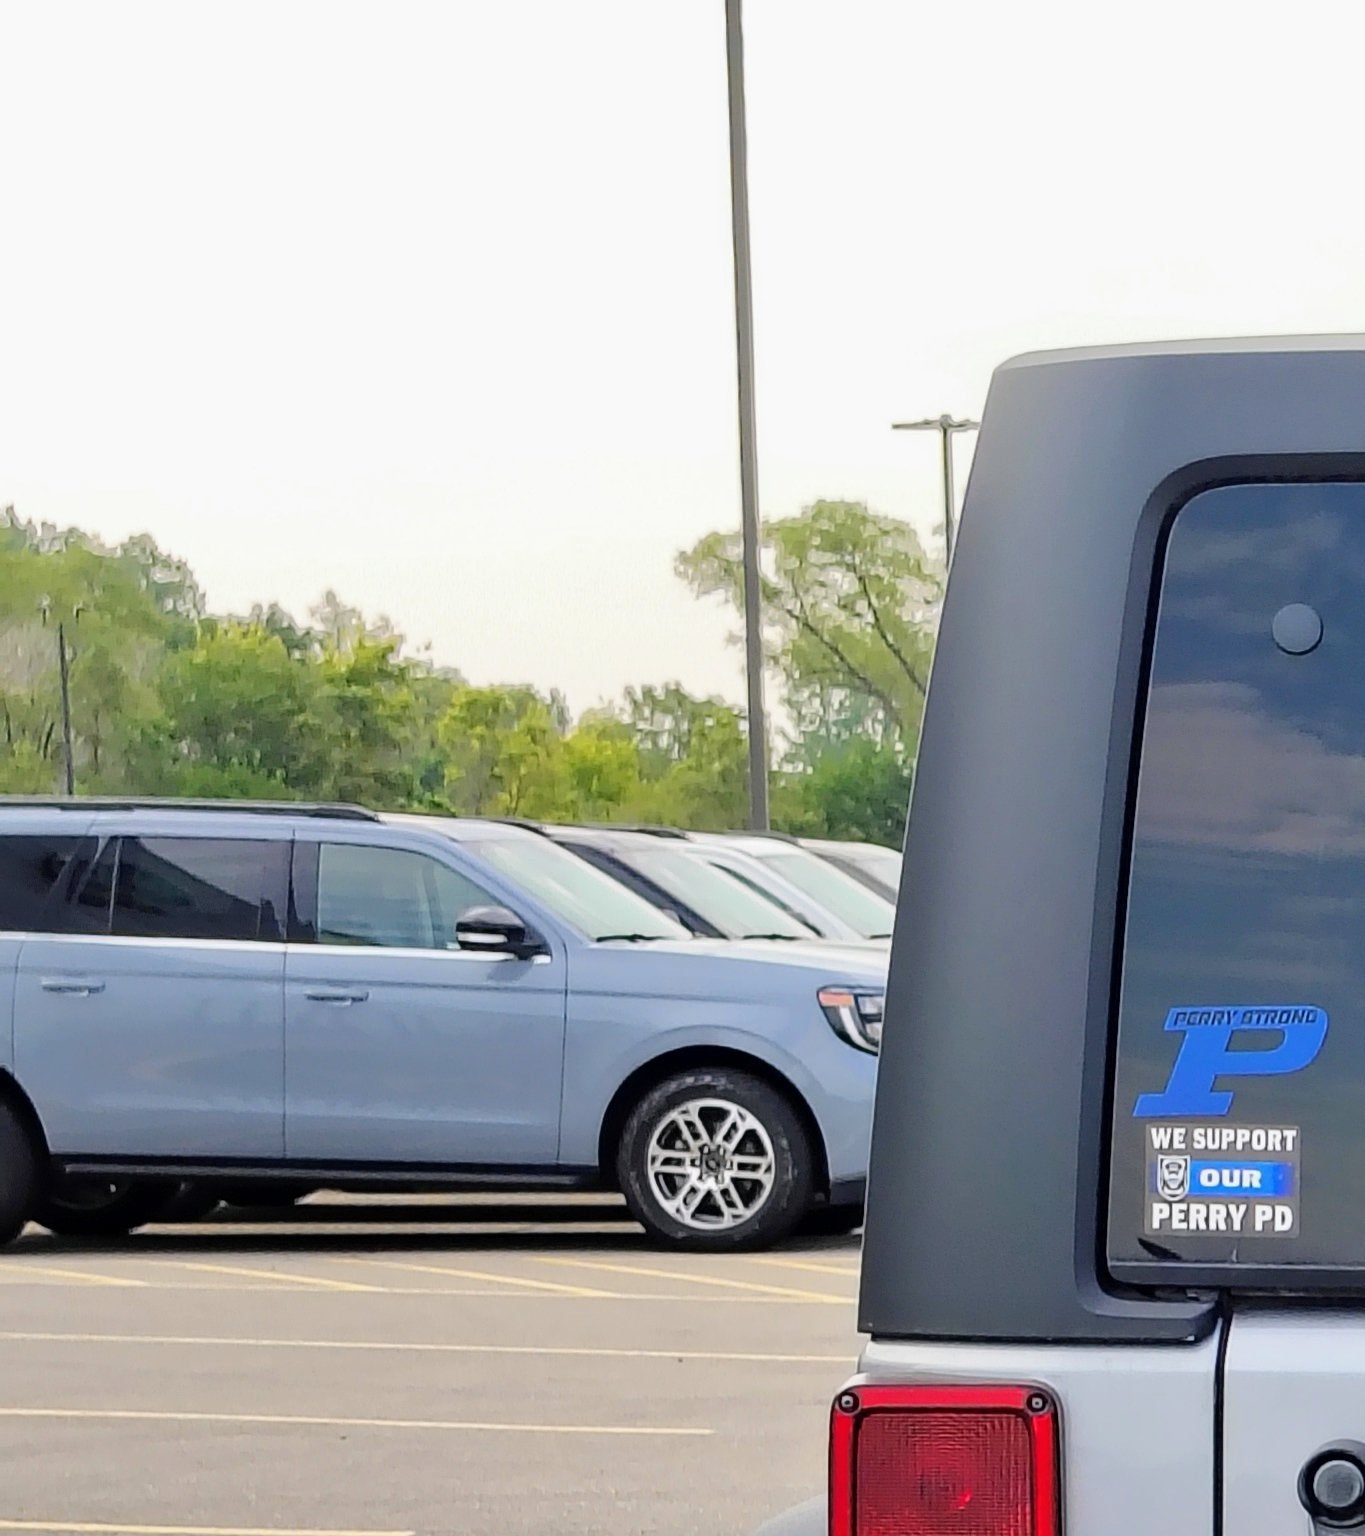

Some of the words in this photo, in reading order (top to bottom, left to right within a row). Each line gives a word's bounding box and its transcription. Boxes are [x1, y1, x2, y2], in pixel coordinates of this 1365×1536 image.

[1174, 1011, 1238, 1026] PERRY
[1241, 1009, 1318, 1025] STRONG
[1150, 1127, 1186, 1149] WE
[1192, 1128, 1297, 1151] SUPPORT
[1199, 1168, 1262, 1188] OUR
[1151, 1202, 1247, 1231] PERRY
[1254, 1204, 1294, 1232] PD
